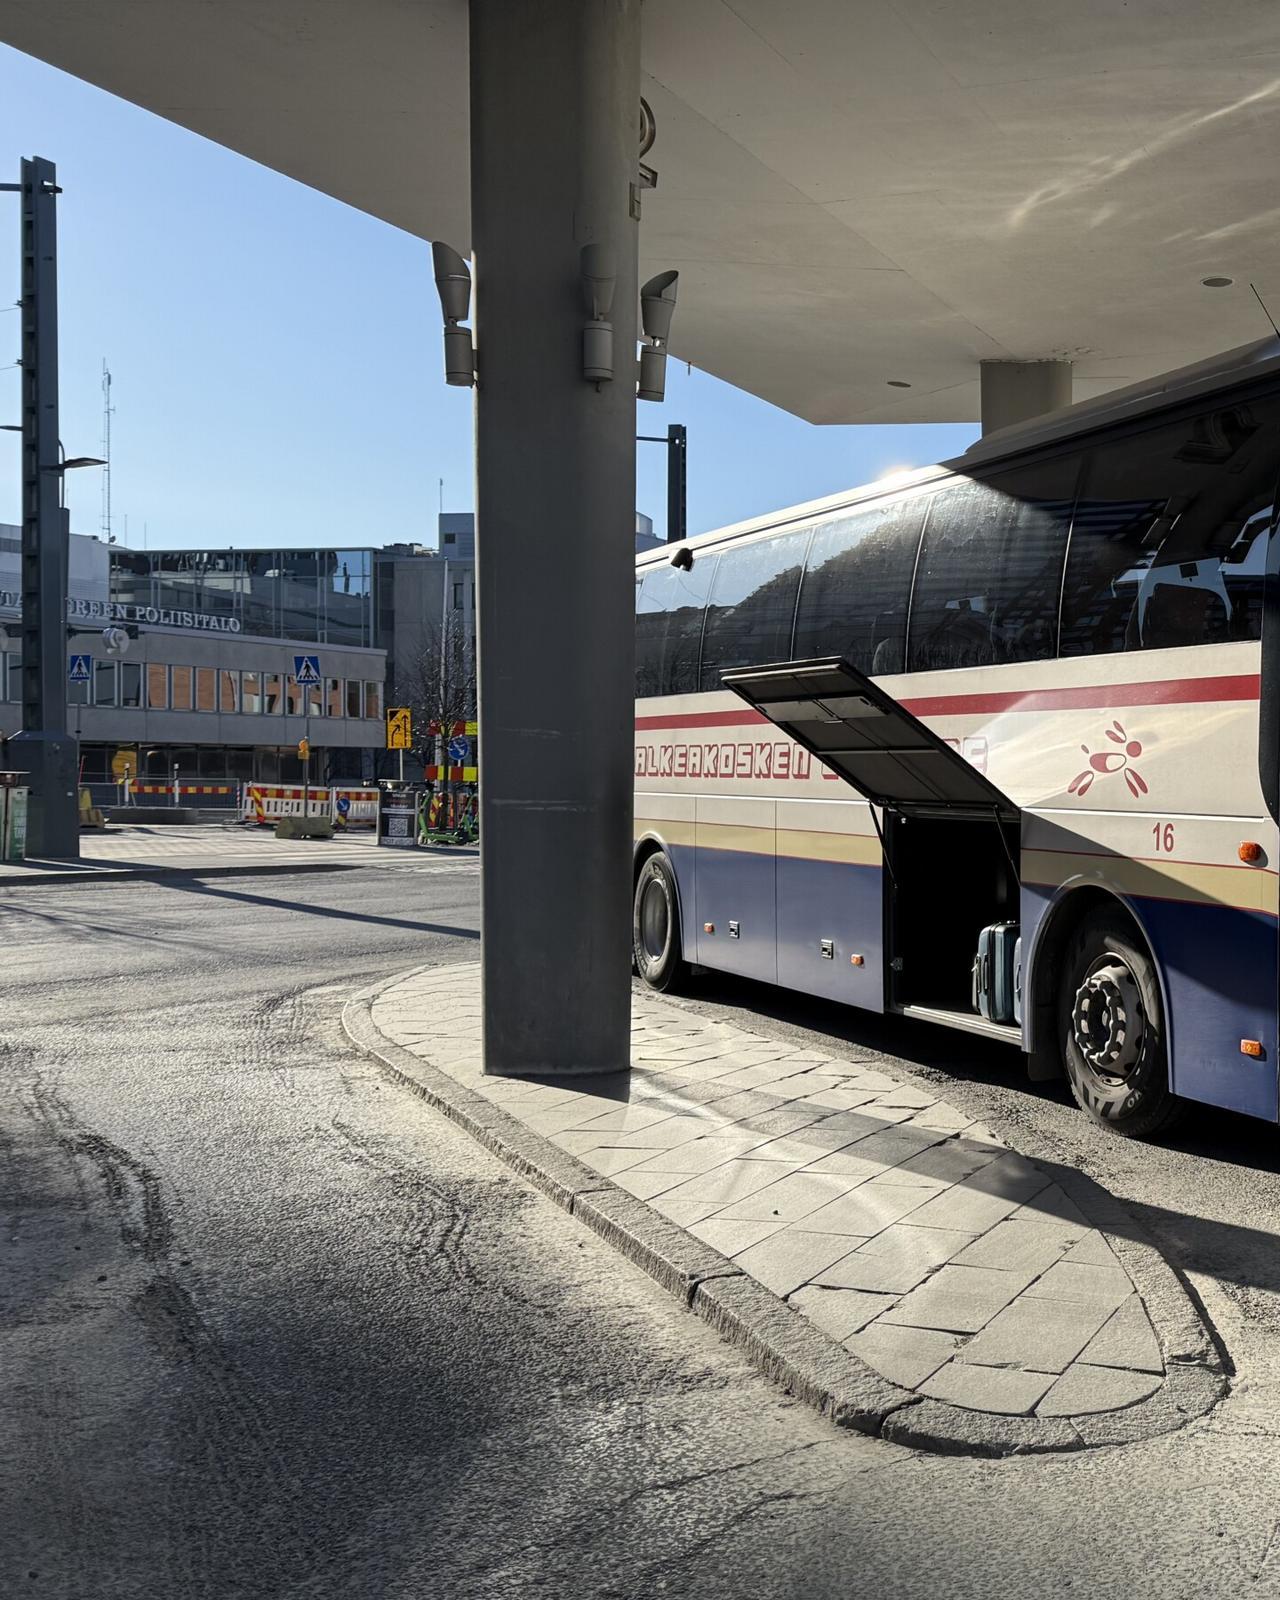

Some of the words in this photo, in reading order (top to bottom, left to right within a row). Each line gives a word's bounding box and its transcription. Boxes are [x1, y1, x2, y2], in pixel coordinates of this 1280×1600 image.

[134, 606, 241, 632] POLIISITALO
[634, 742, 811, 780] ALKEAKOSKEN
[1153, 822, 1174, 852] 16
